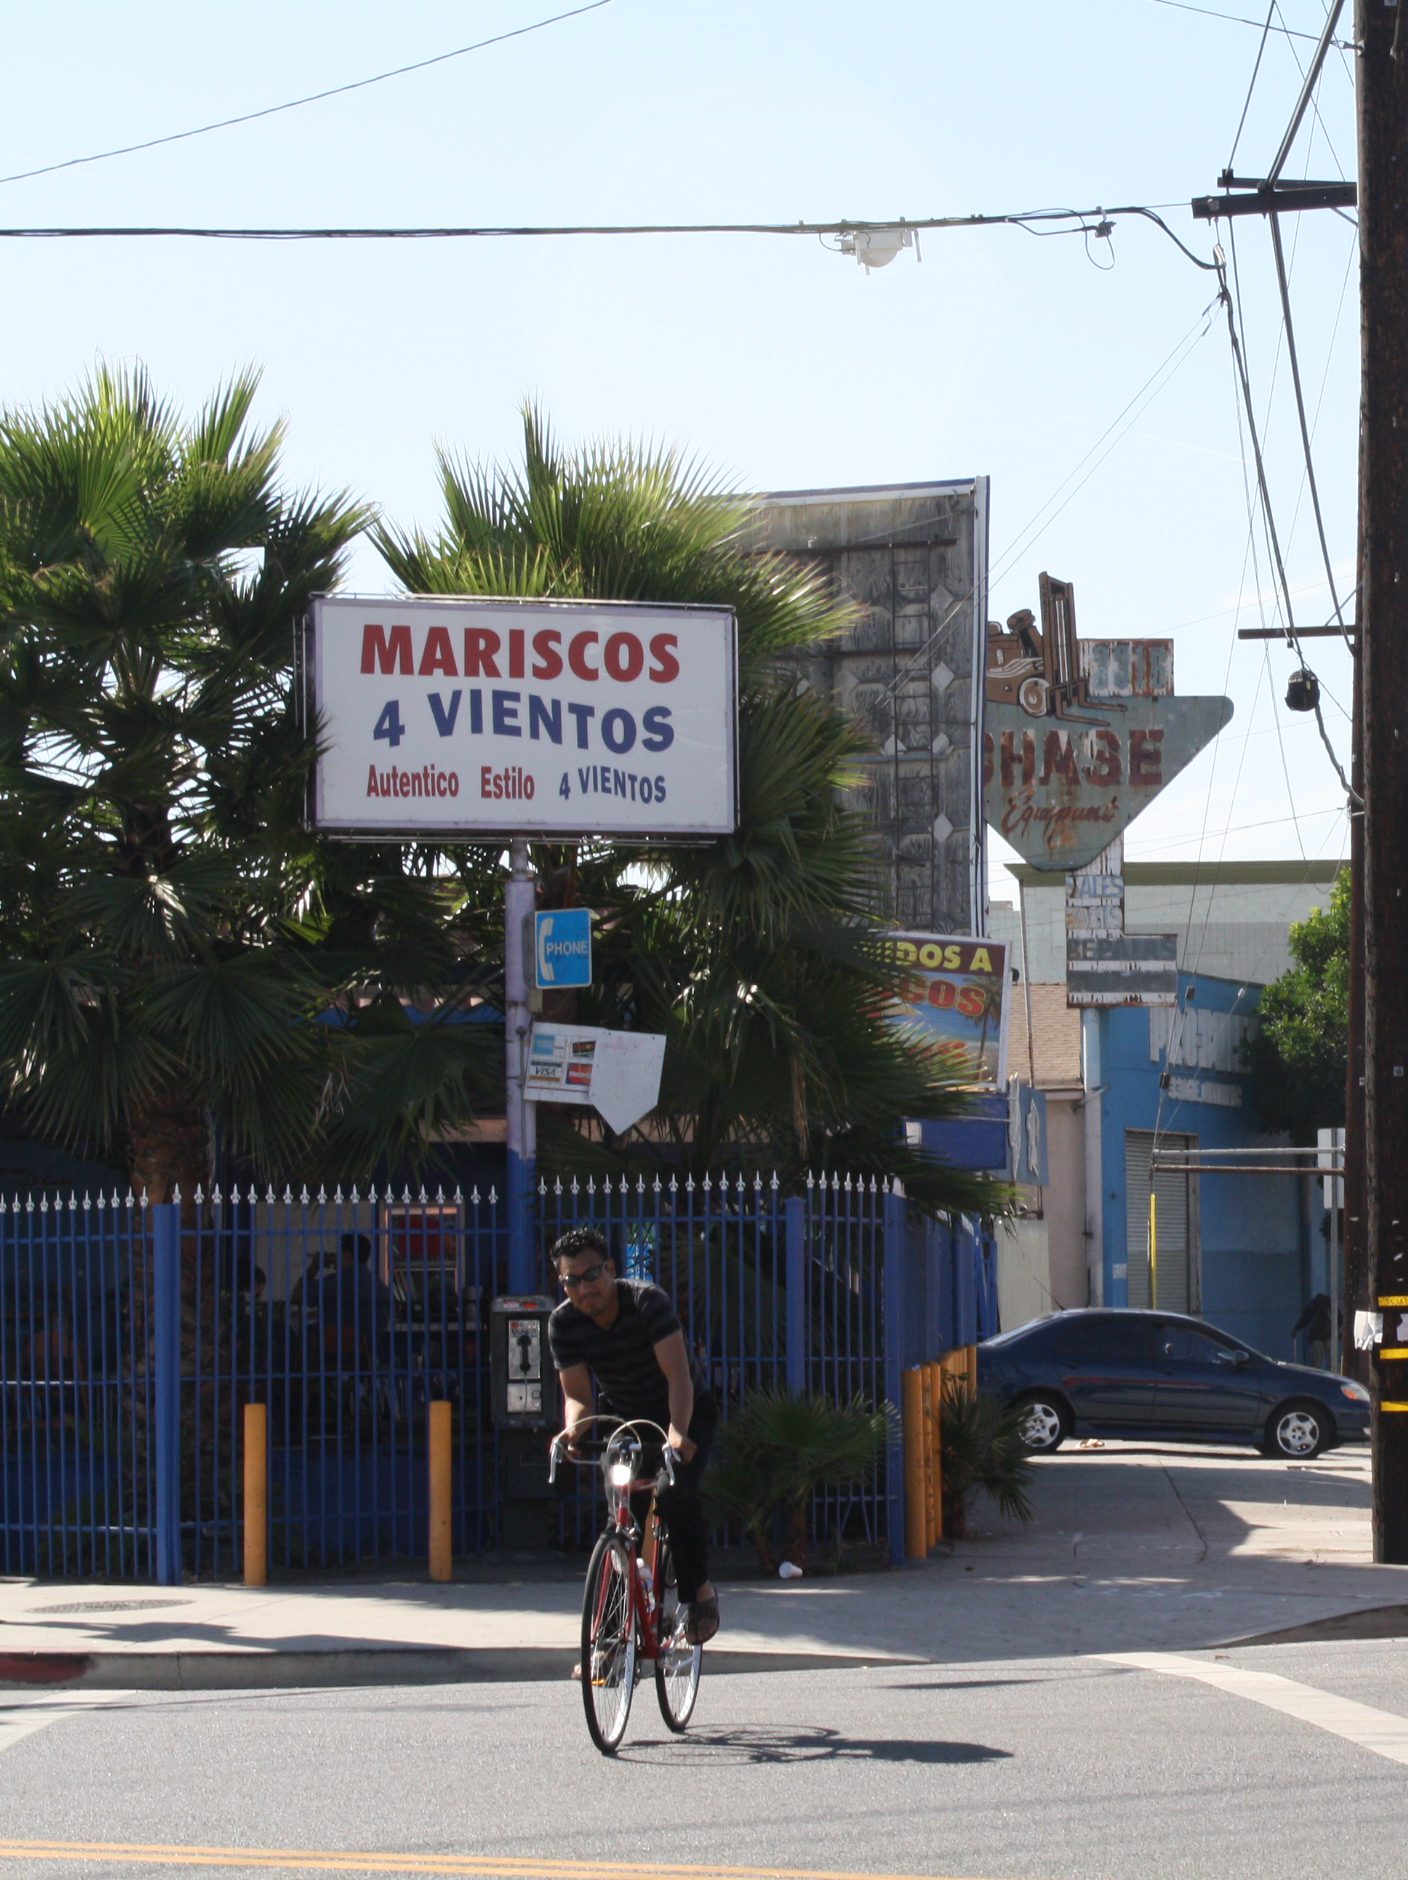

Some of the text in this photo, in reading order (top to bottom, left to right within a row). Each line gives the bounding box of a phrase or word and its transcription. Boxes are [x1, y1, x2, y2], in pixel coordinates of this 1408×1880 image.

[360, 624, 680, 683] MARISCOS
[373, 689, 675, 755] 4 VIENTOS
[366, 764, 666, 804] Autentico Estilo 4 VIENTOS
[546, 941, 588, 955] PHONE
[969, 948, 993, 972] A
